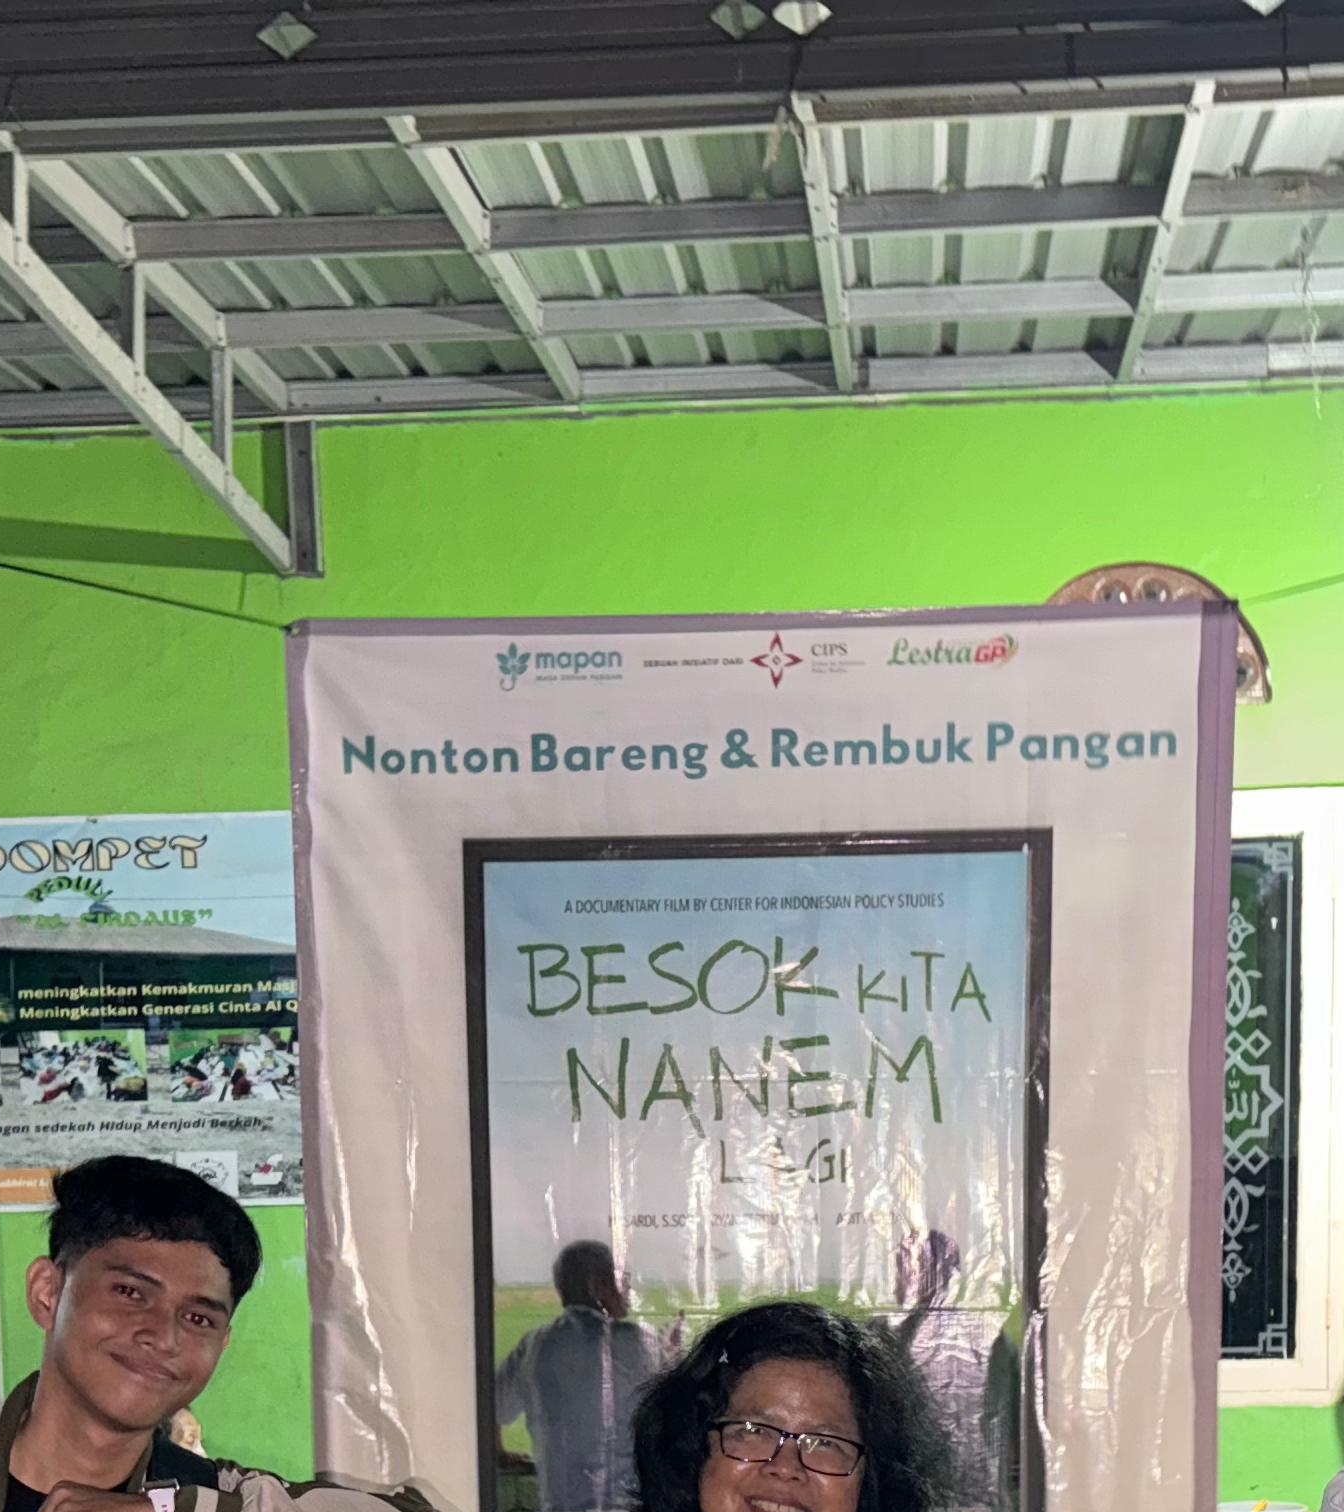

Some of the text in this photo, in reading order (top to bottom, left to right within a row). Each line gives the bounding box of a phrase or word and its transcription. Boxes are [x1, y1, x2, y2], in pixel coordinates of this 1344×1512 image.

[811, 642, 848, 658] CIPS
[535, 650, 623, 674] mapan
[342, 721, 1177, 780] Nonton Bareng & Rembuk Pangan
[564, 892, 945, 914] A DOCUMENTARY FILM BY CENTER FOR INDONESIAN POLICY STUDIES
[517, 936, 993, 1023] BESOK KITA
[18, 984, 138, 1003] meningkatkan
[141, 981, 253, 997] Kemakmuran
[19, 1004, 138, 1021] Meningkatkan
[142, 1002, 215, 1016] Generasi
[218, 1000, 262, 1014] Cinta
[565, 1033, 943, 1139] NANEM
[35, 1121, 95, 1134] sedekah
[99, 1120, 142, 1134] Hidup
[147, 1118, 206, 1133] Menjadi
